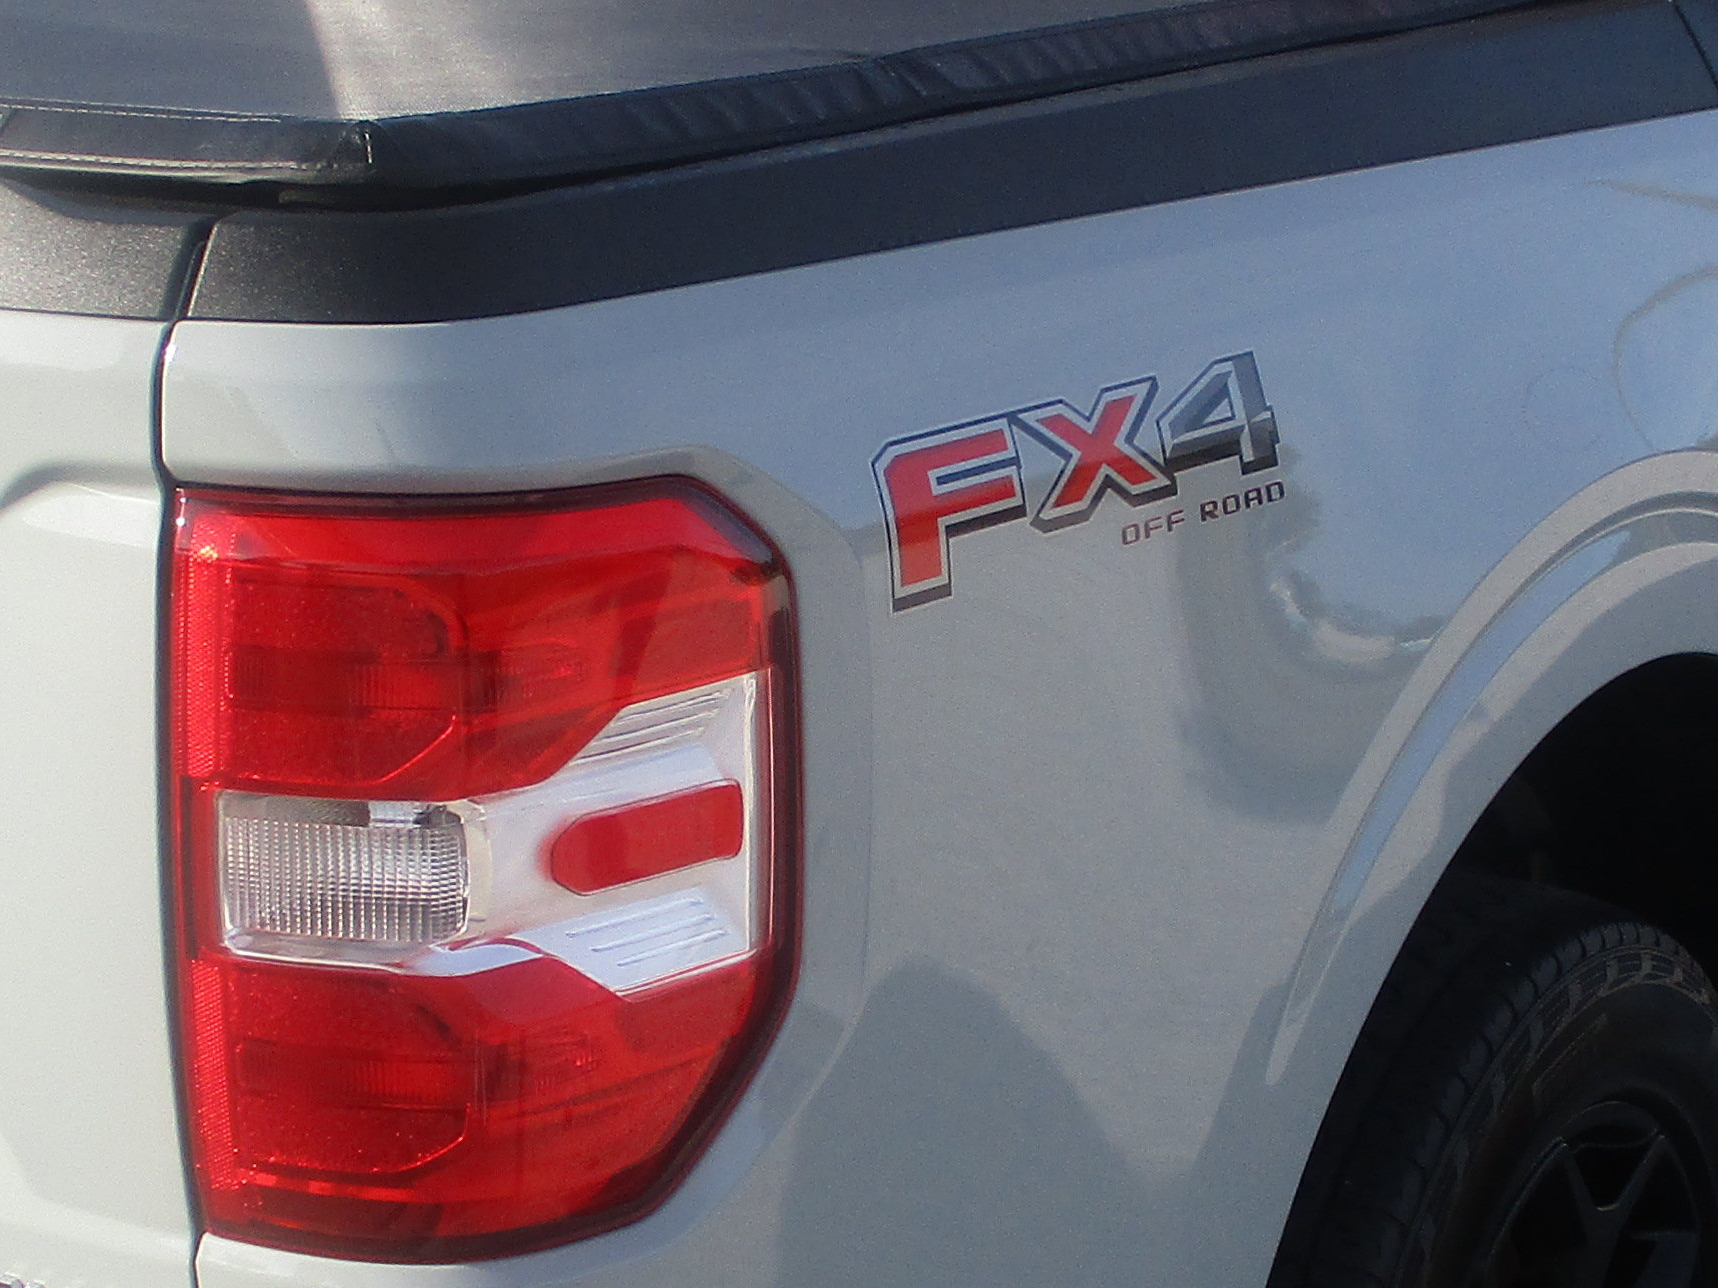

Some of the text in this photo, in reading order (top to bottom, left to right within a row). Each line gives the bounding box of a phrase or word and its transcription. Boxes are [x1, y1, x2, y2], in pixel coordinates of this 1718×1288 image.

[871, 351, 1279, 613] FX4
[1121, 480, 1285, 546] OFF ROAD
